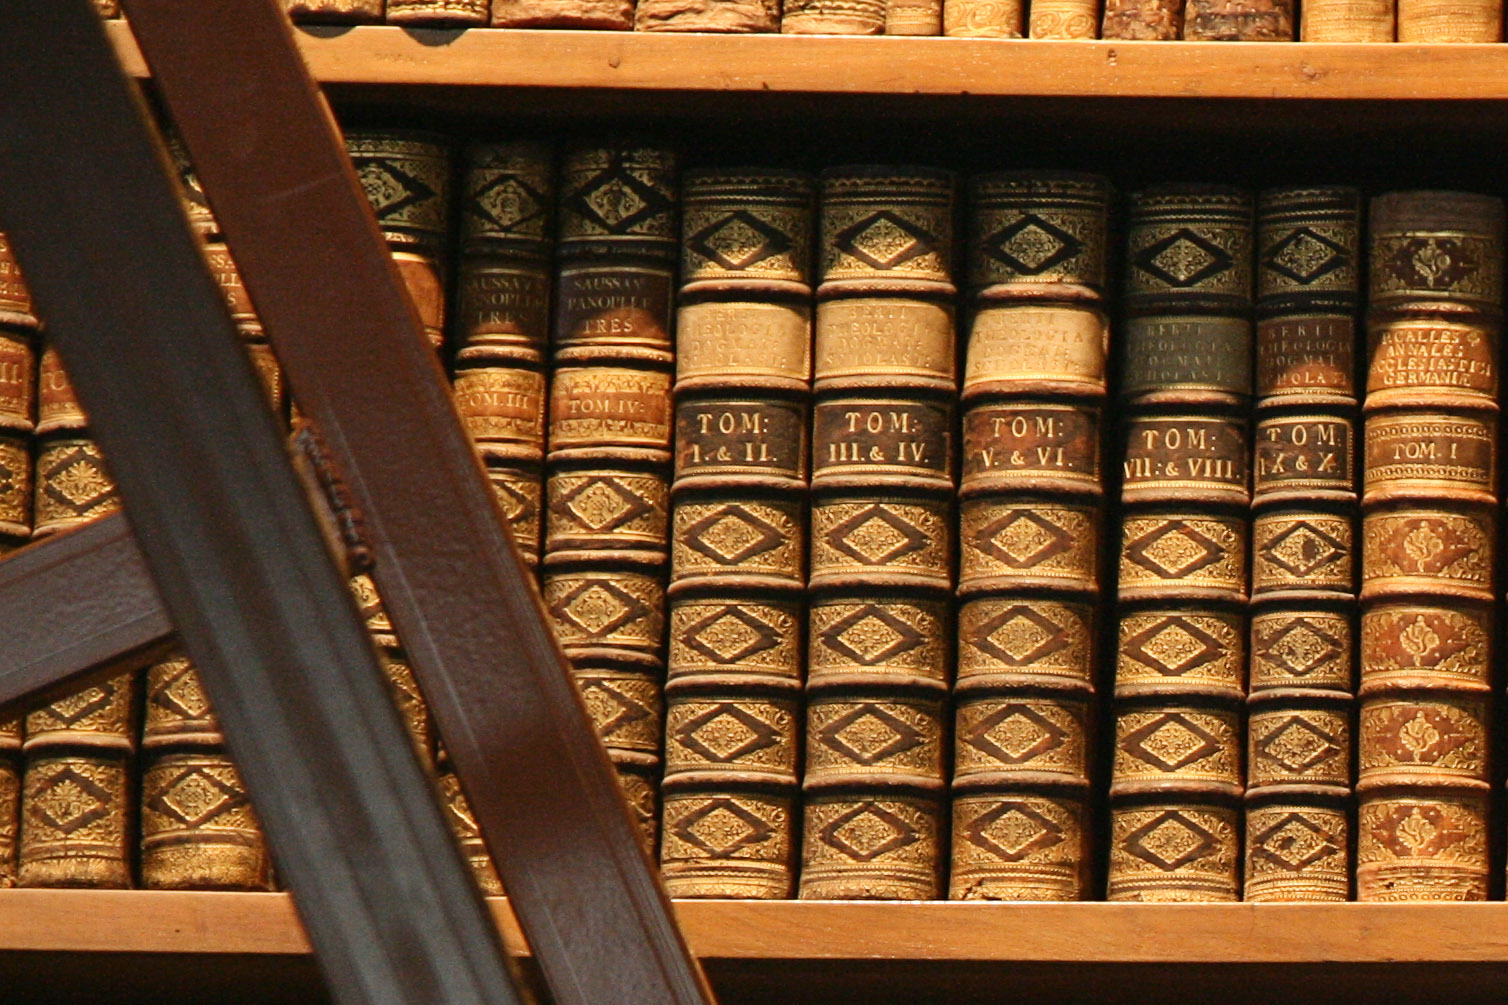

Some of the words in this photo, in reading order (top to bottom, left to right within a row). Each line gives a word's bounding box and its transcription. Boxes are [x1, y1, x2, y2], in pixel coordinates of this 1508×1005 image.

[697, 413, 769, 434] TOM:
[845, 412, 919, 433] TOM:
[991, 416, 1063, 438] TOM:
[1142, 428, 1216, 451] TOM:
[1010, 450, 1025, 466] &
[1296, 455, 1308, 471] &
